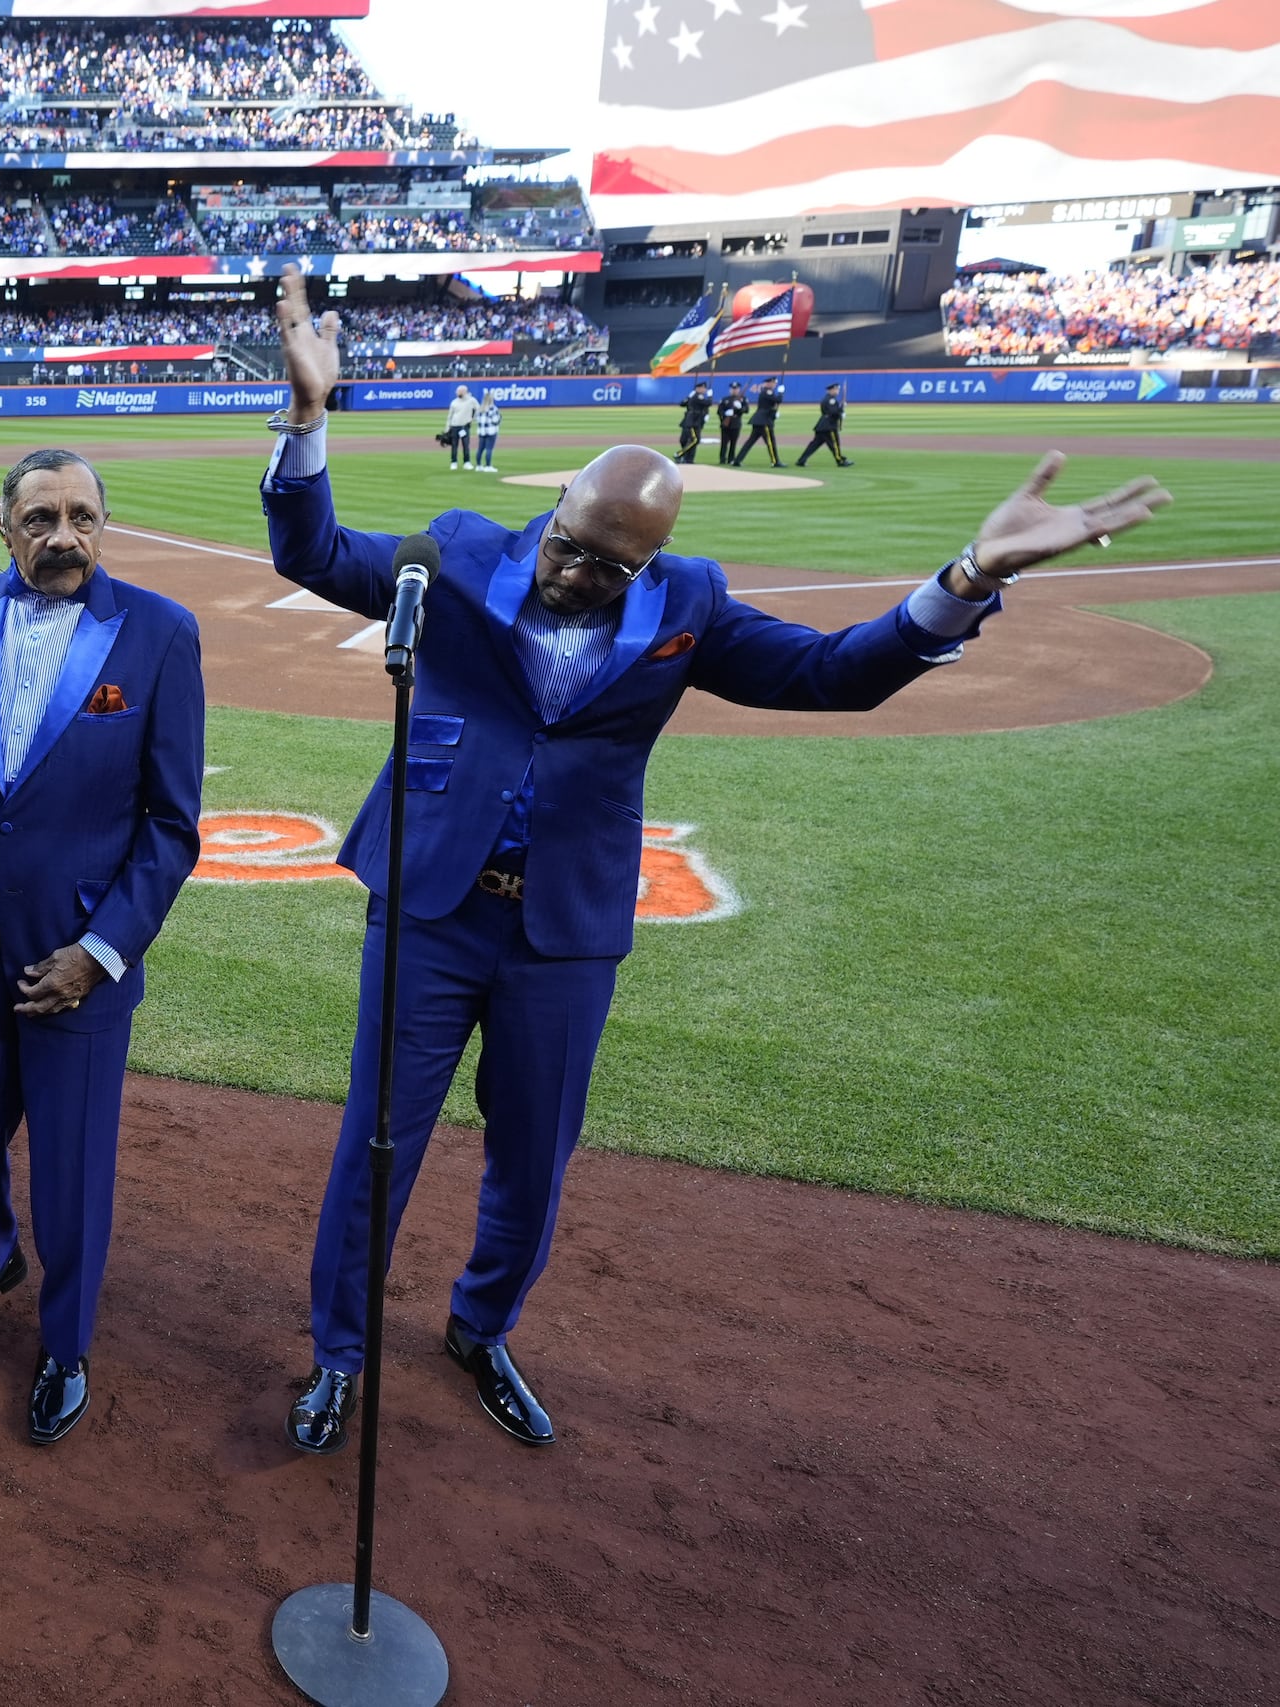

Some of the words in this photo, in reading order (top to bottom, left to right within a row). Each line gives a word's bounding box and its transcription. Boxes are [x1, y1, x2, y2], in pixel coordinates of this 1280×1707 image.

[921, 380, 987, 394] DELTA
[1066, 380, 1136, 391] HAUGLAND
[94, 390, 157, 406] National
[203, 390, 283, 406] Northwell
[378, 390, 413, 400] Invesco
[592, 383, 622, 401] citi
[1064, 391, 1108, 402] GROUP
[1178, 388, 1206, 402] 380
[25, 396, 47, 407] 358
[115, 405, 128, 413] Car
[130, 404, 154, 413] Rental
